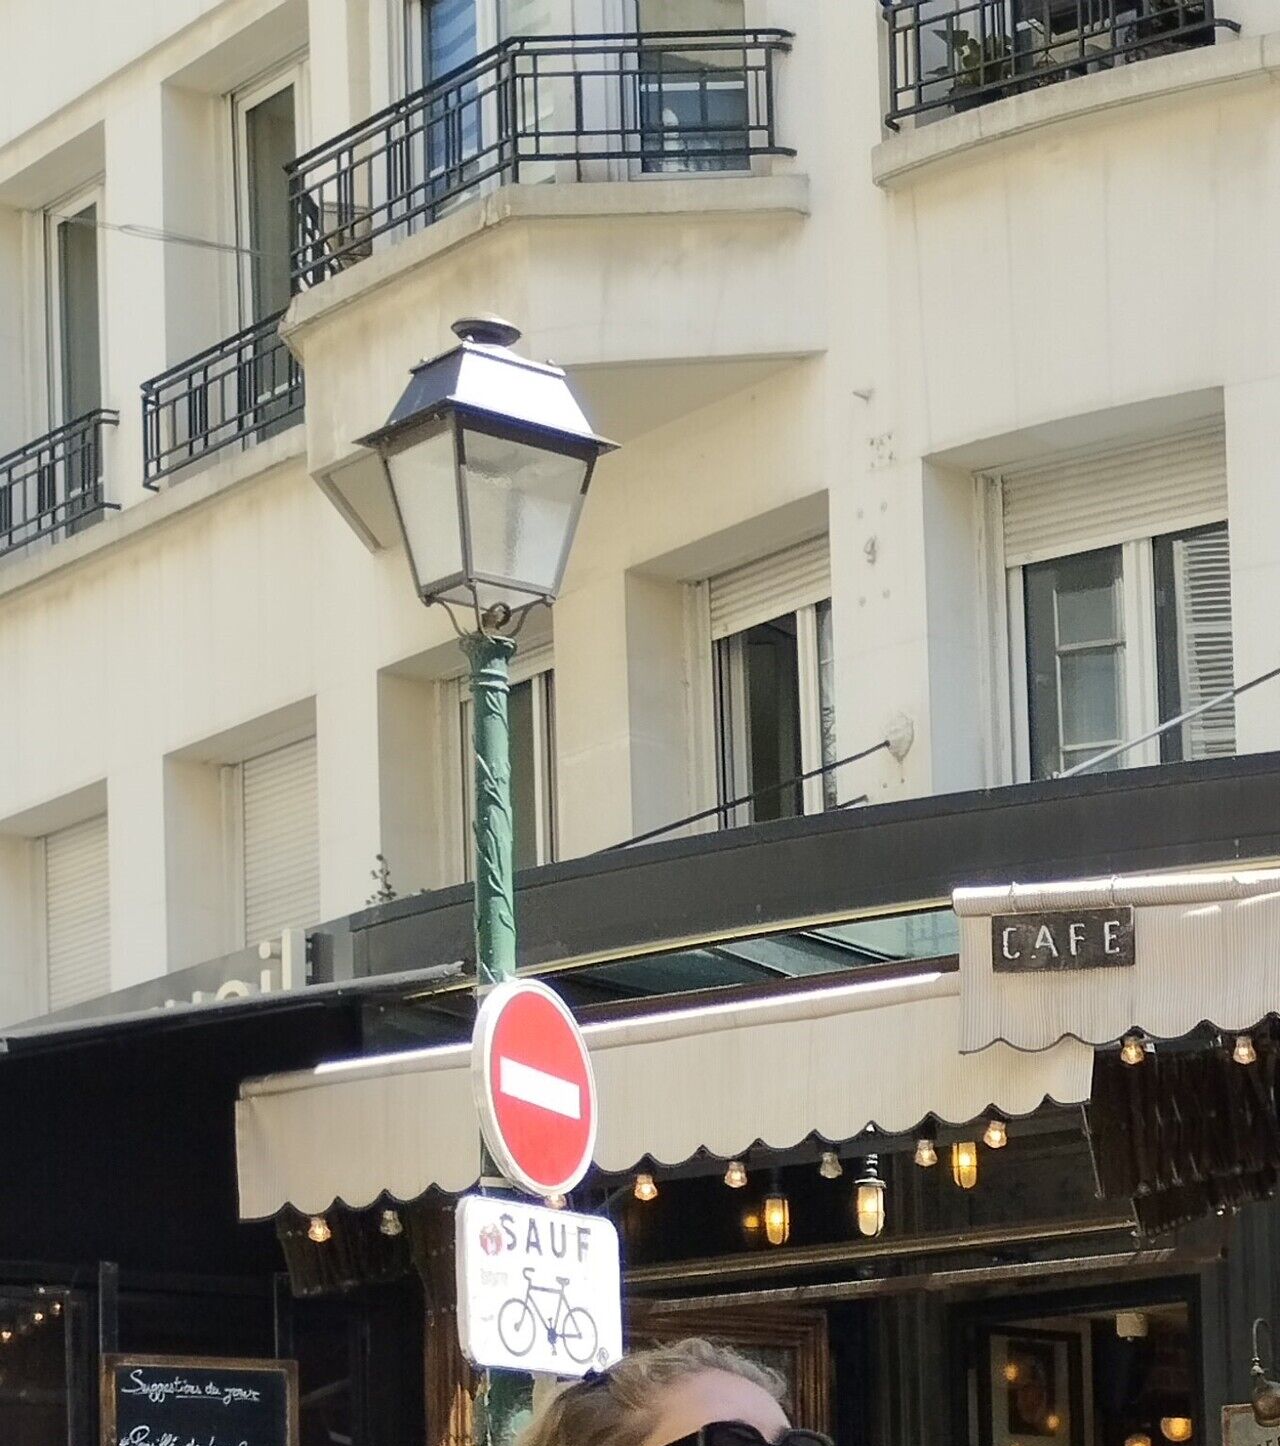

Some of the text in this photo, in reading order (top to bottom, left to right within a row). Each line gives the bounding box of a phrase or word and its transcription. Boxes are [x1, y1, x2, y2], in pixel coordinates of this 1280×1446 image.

[1002, 920, 1121, 960] CAFE
[499, 1213, 592, 1263] SAUF
[121, 1368, 261, 1405] Suggestions du jour
